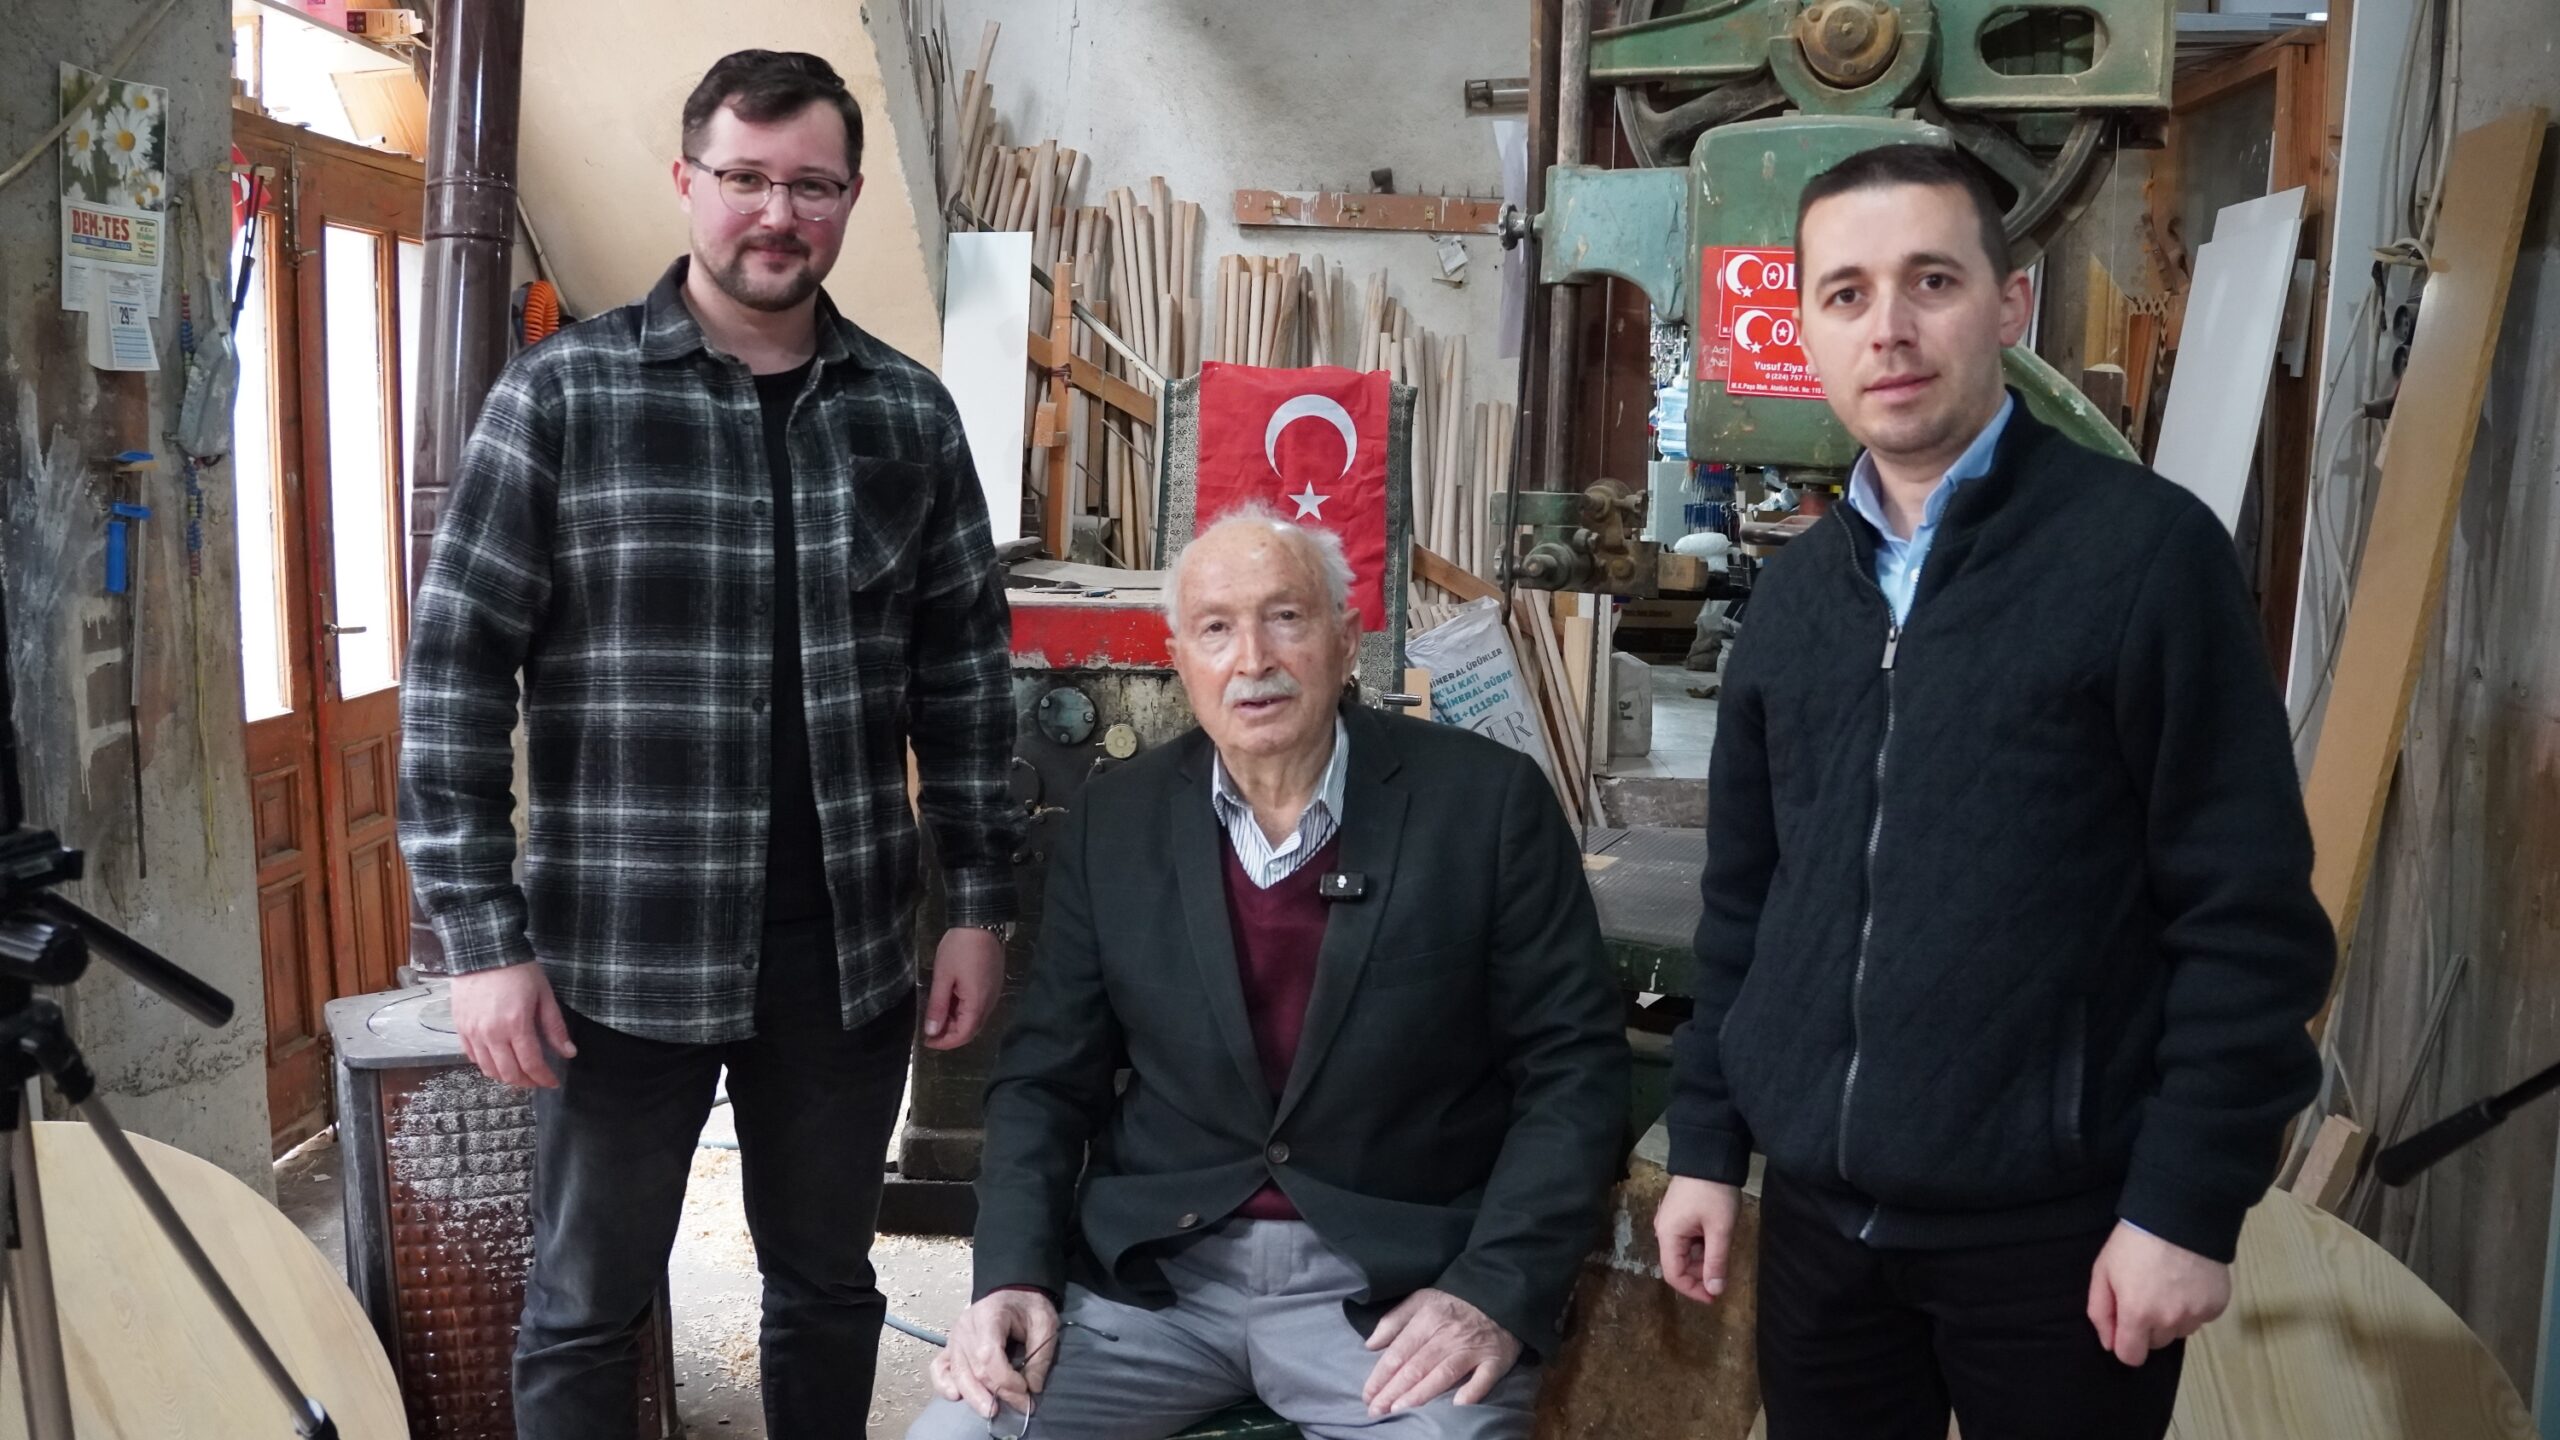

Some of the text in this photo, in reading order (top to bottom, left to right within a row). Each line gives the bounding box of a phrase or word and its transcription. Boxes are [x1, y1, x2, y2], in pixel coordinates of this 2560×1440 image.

[120, 306, 130, 325] 29
[1754, 361, 1781, 371] Yusuf
[1783, 362, 1803, 374] Ziya
[1771, 373, 1788, 381] (224)
[1466, 648, 1503, 671] ÜRÜNLER
